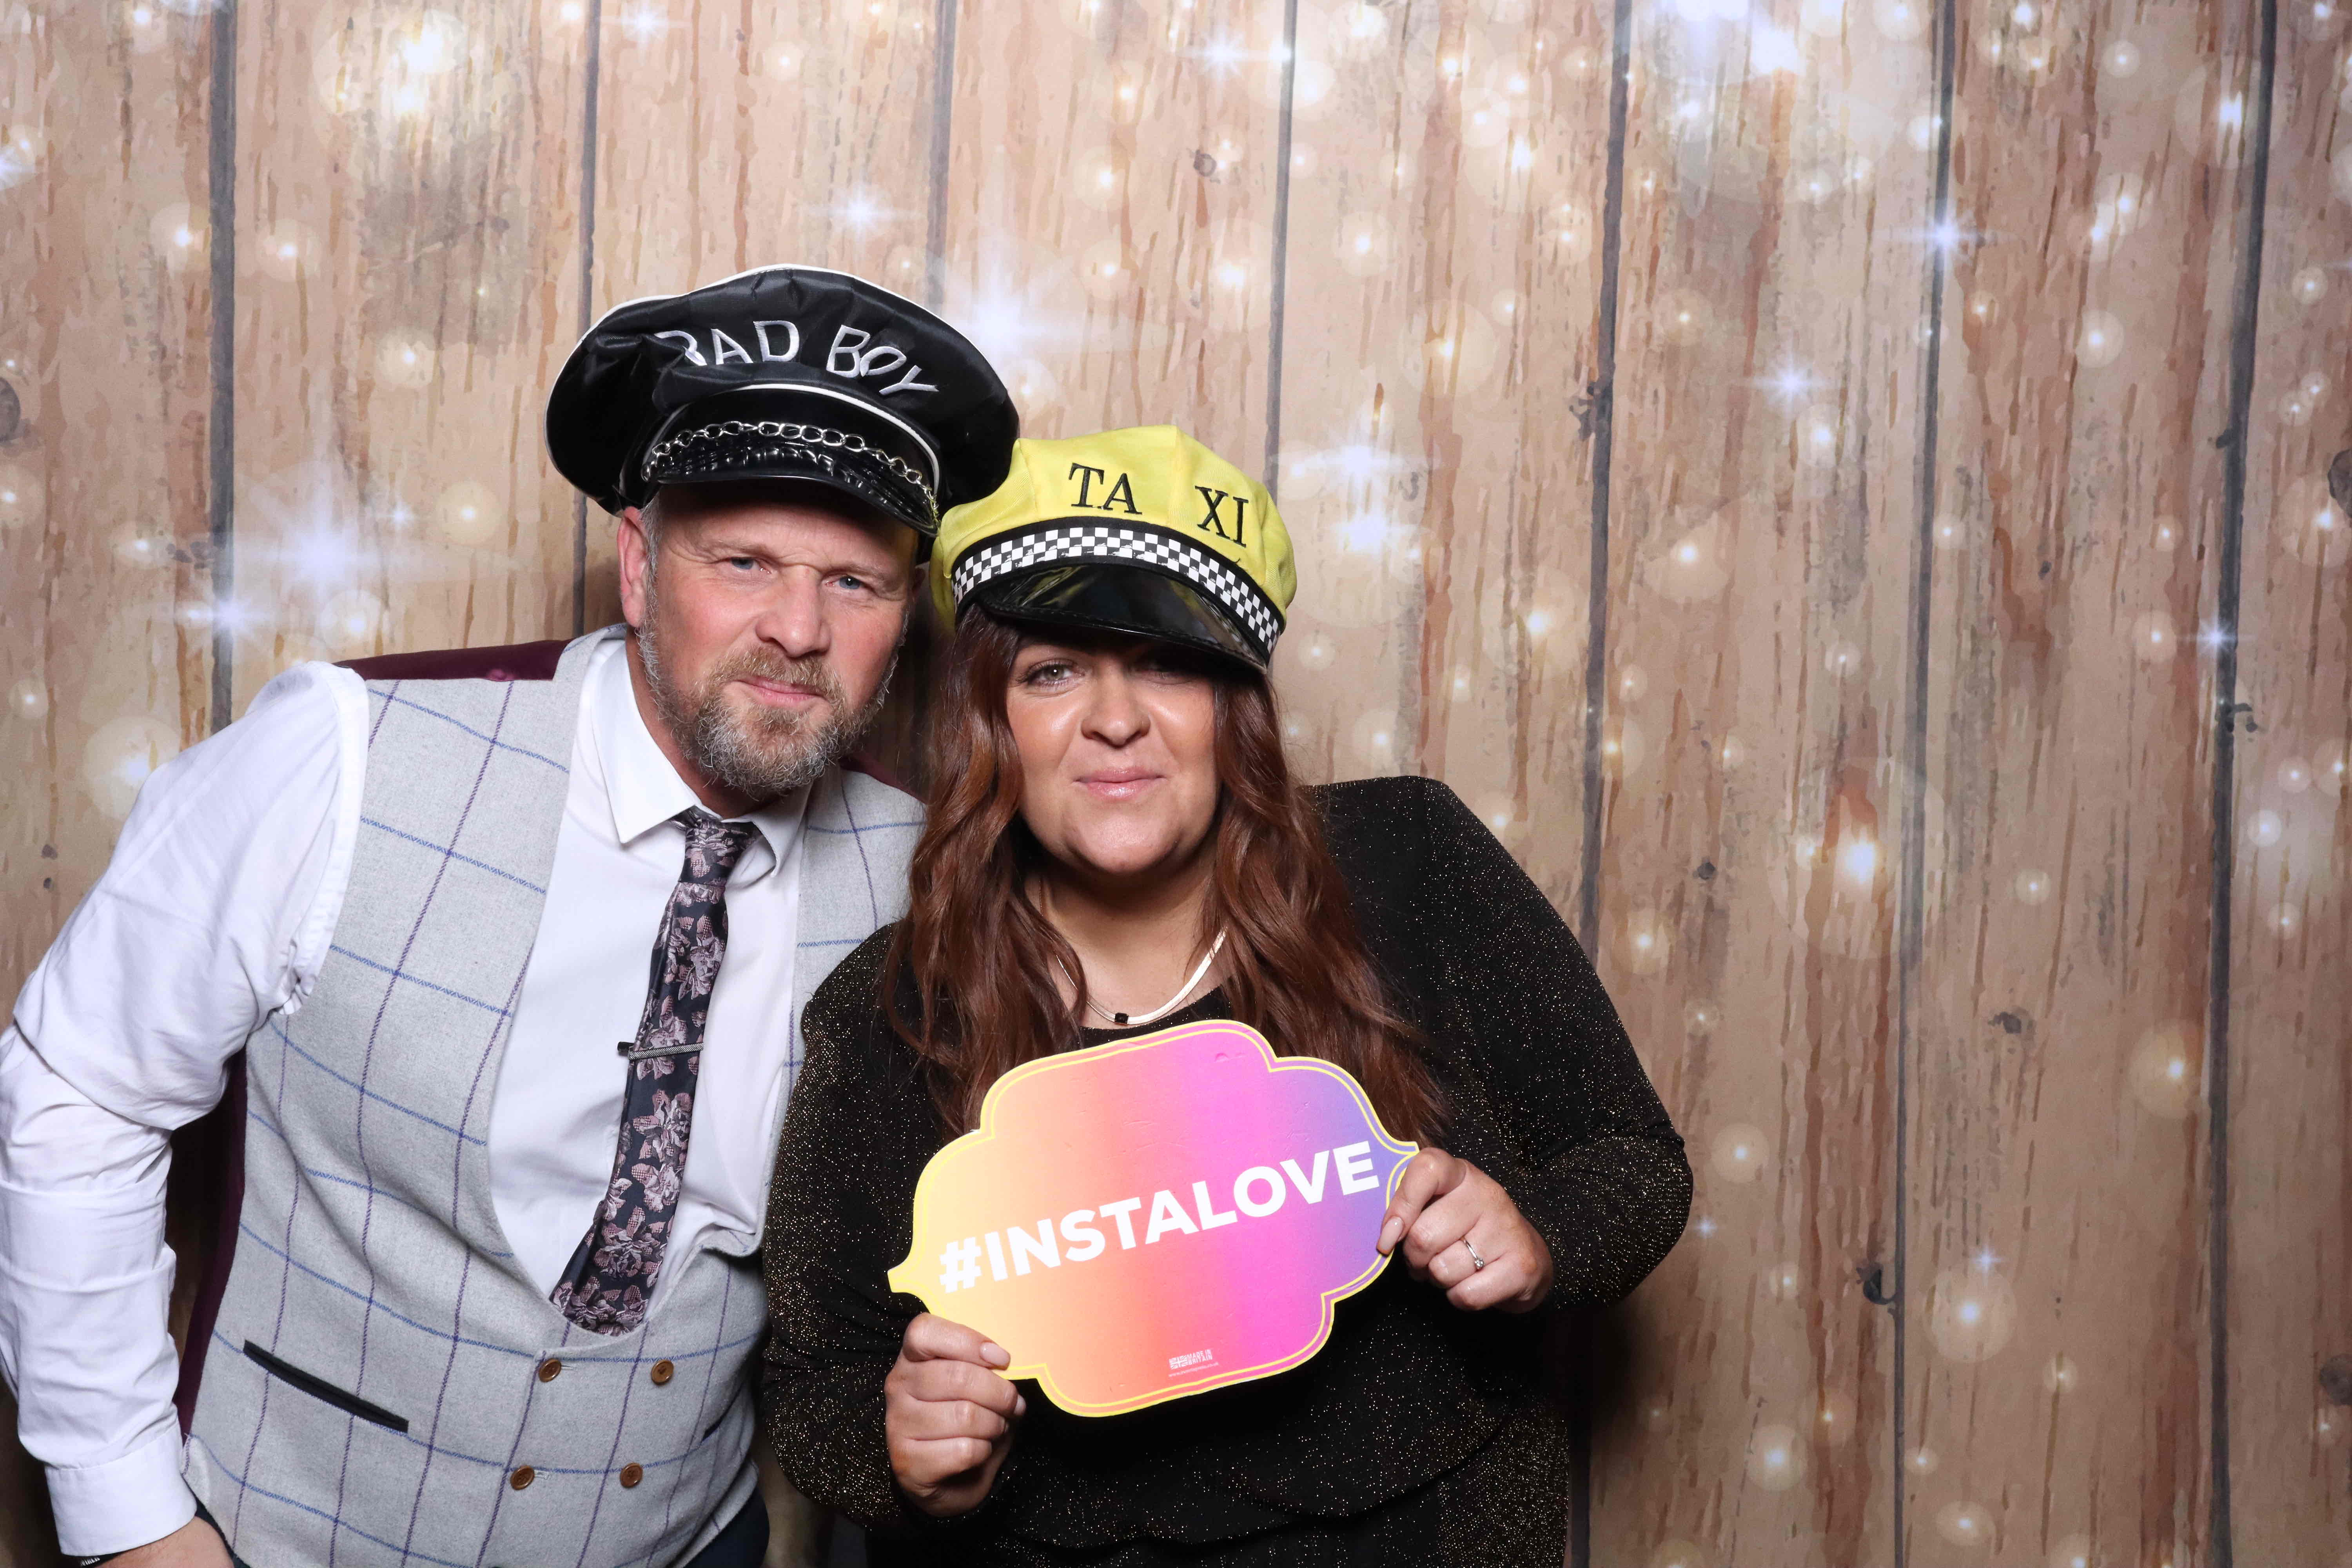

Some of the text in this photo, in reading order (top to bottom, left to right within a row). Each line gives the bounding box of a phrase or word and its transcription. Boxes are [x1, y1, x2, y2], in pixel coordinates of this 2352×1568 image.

[826, 324, 939, 396] BOY
[938, 1140, 1379, 1294] #INSTALOVE
[1187, 1350, 1204, 1359] MADE
[1188, 1354, 1213, 1365] BRITAIN
